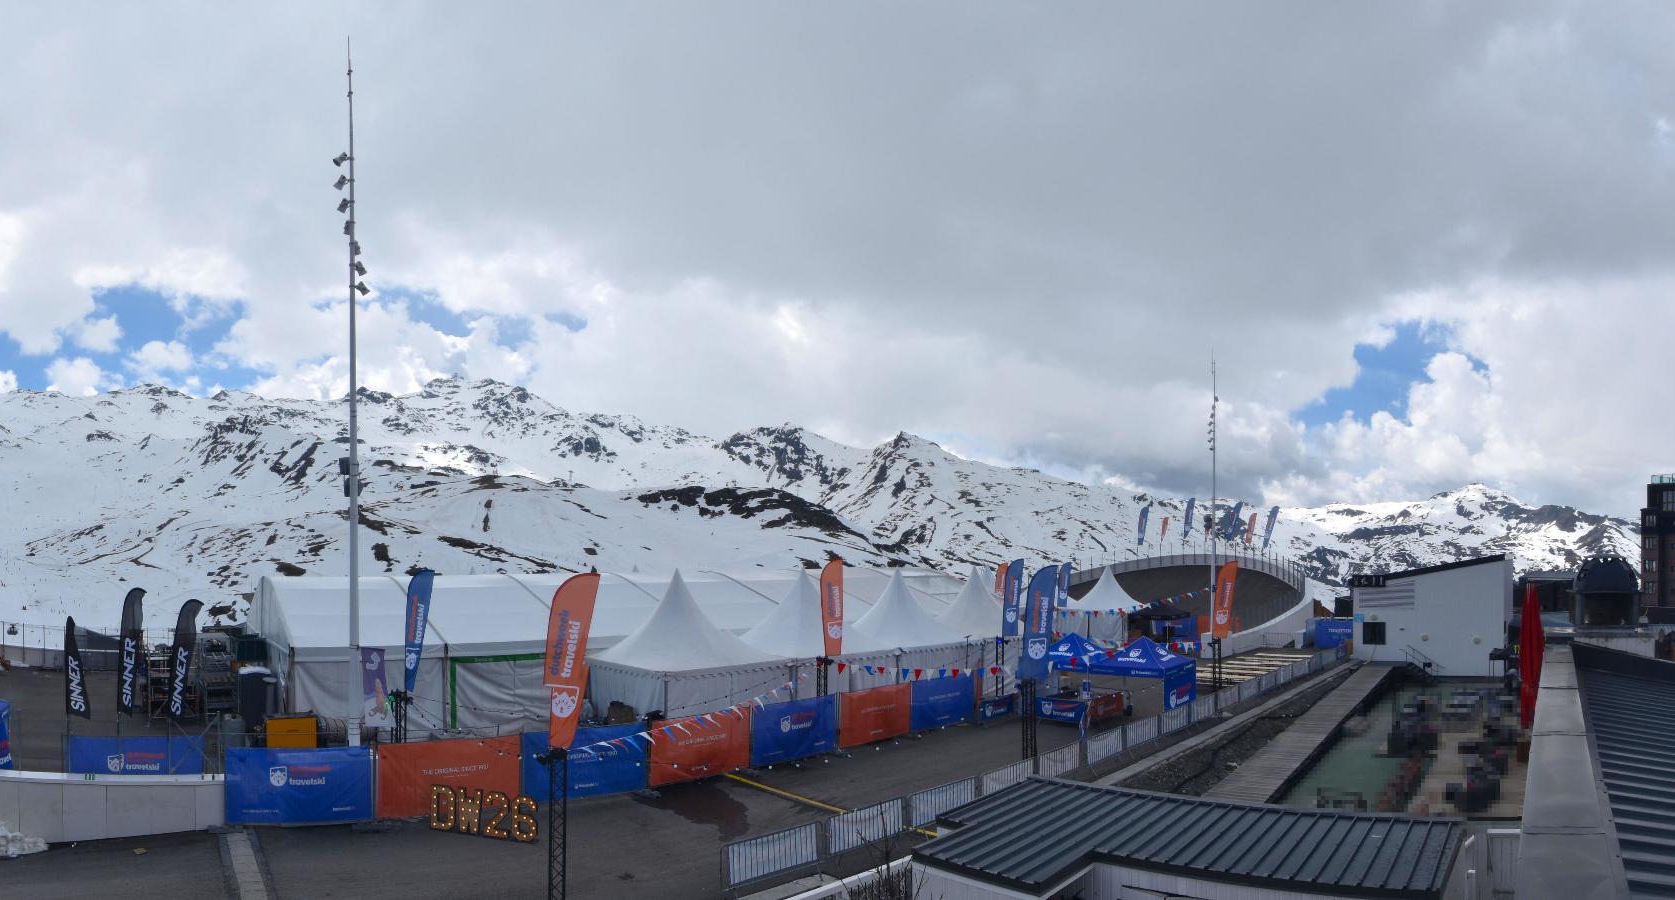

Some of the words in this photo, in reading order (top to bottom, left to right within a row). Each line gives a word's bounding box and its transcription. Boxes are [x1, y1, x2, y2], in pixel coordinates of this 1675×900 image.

[414, 602, 425, 644] travelski
[549, 608, 570, 677] dutchweek
[560, 619, 581, 678] travelski
[68, 655, 85, 711] SINNER
[122, 637, 137, 708] SINNER
[171, 646, 189, 715] SINNER
[288, 777, 326, 786] travelski
[429, 783, 539, 843] DW26
